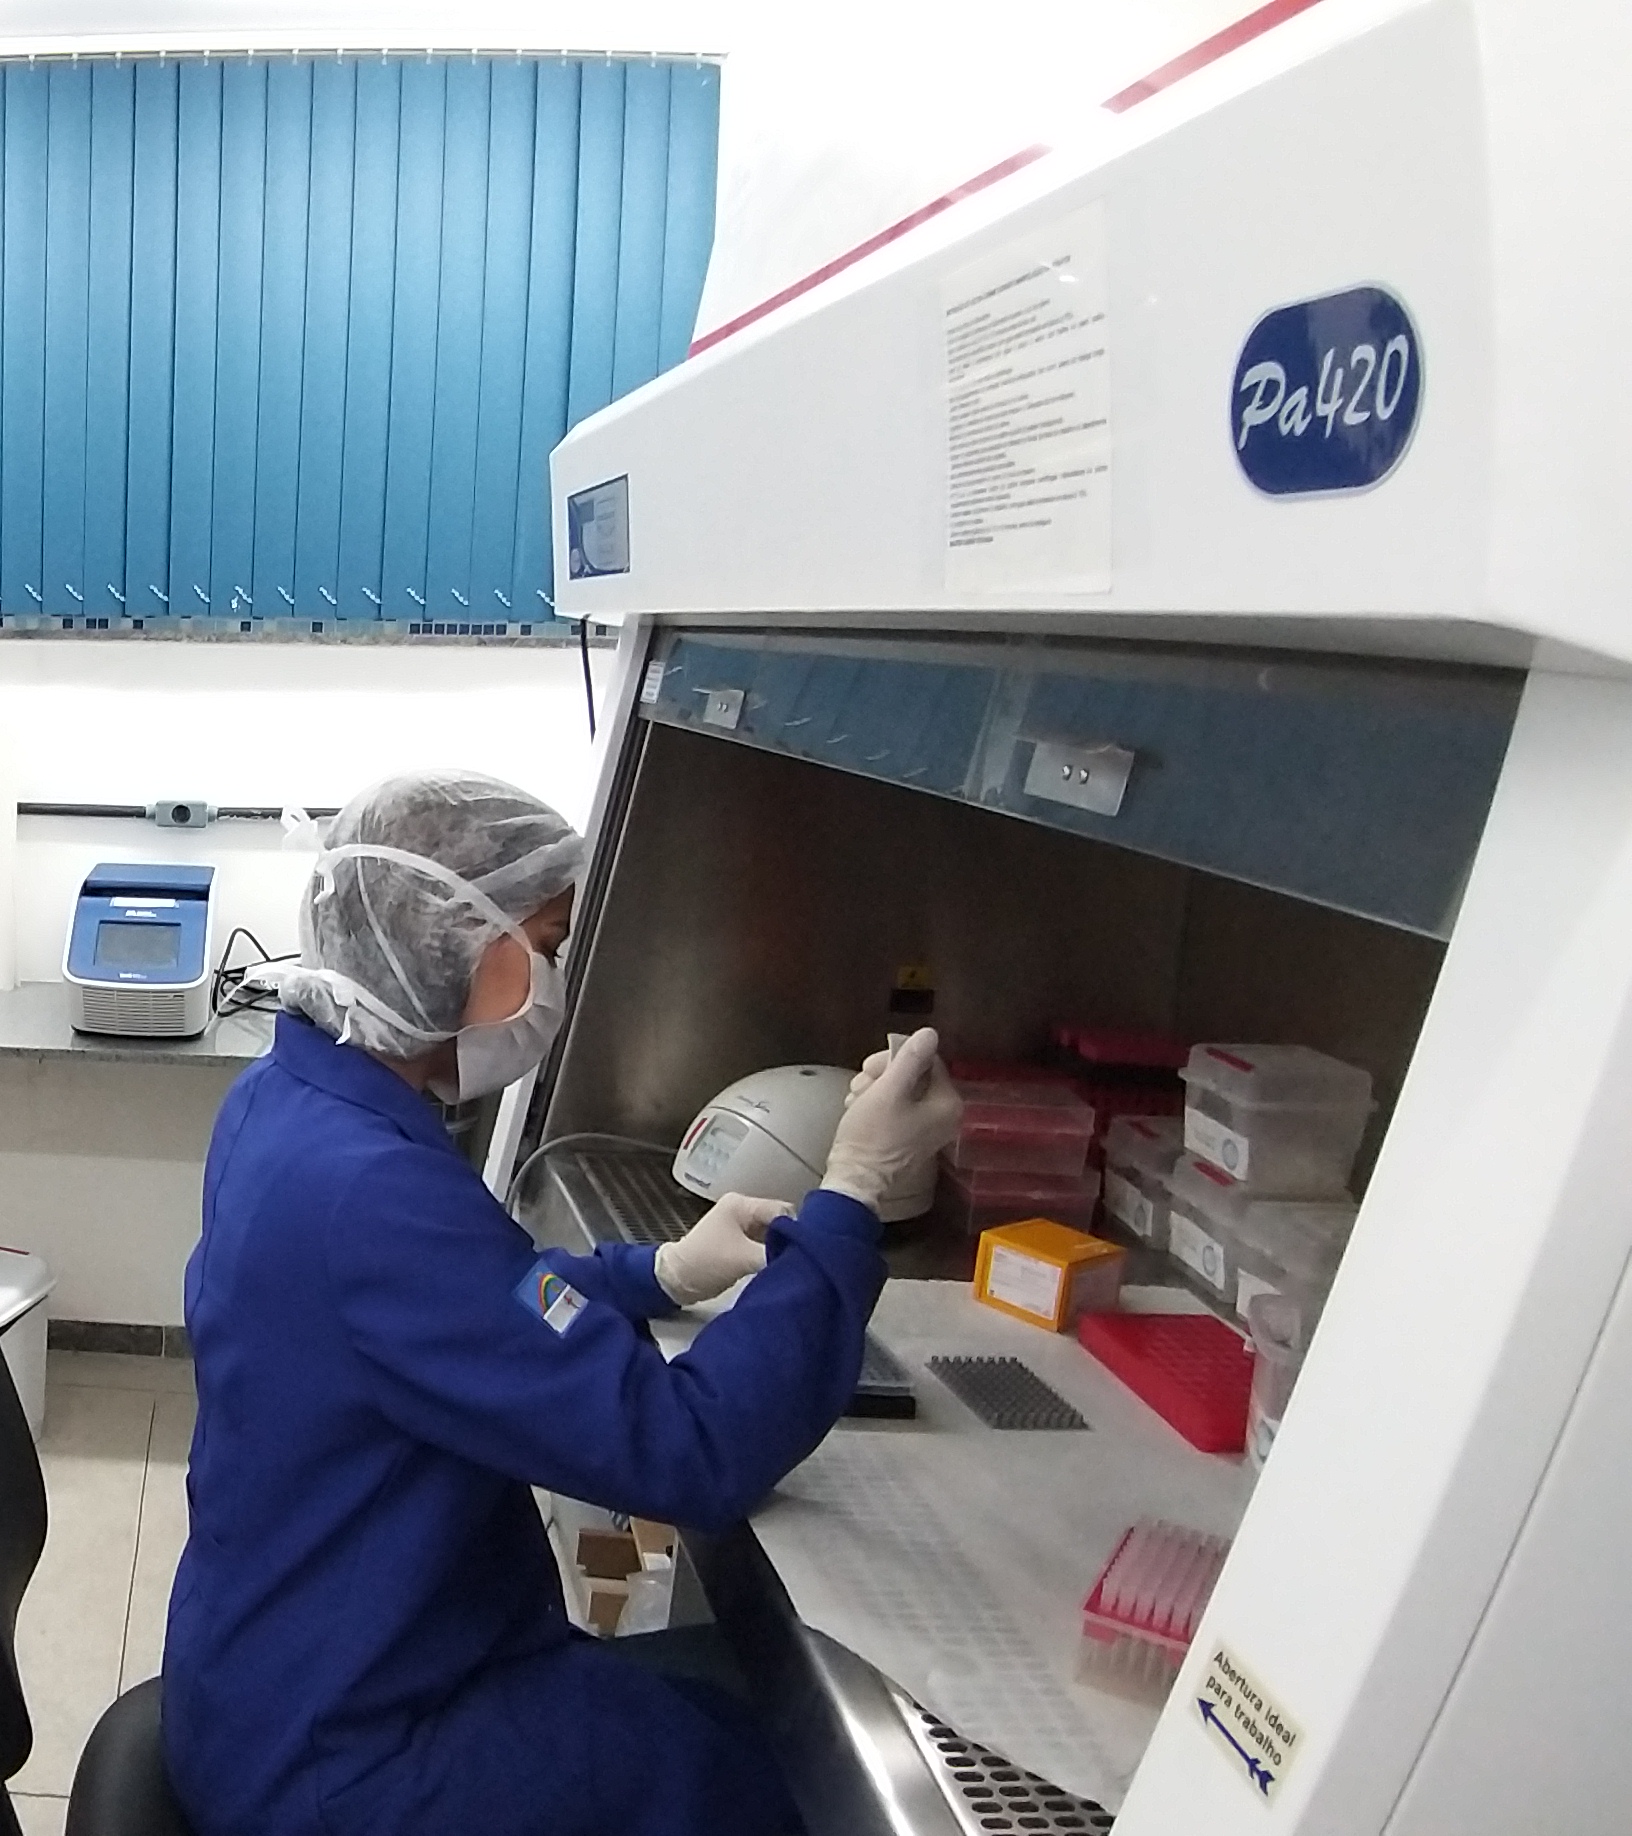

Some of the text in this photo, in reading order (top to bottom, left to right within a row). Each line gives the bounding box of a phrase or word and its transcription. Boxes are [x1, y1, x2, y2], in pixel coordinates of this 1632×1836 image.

[1238, 334, 1409, 451] Pa420
[1206, 1675, 1282, 1766] para trabalho
[1214, 1651, 1263, 1712] Abertura
